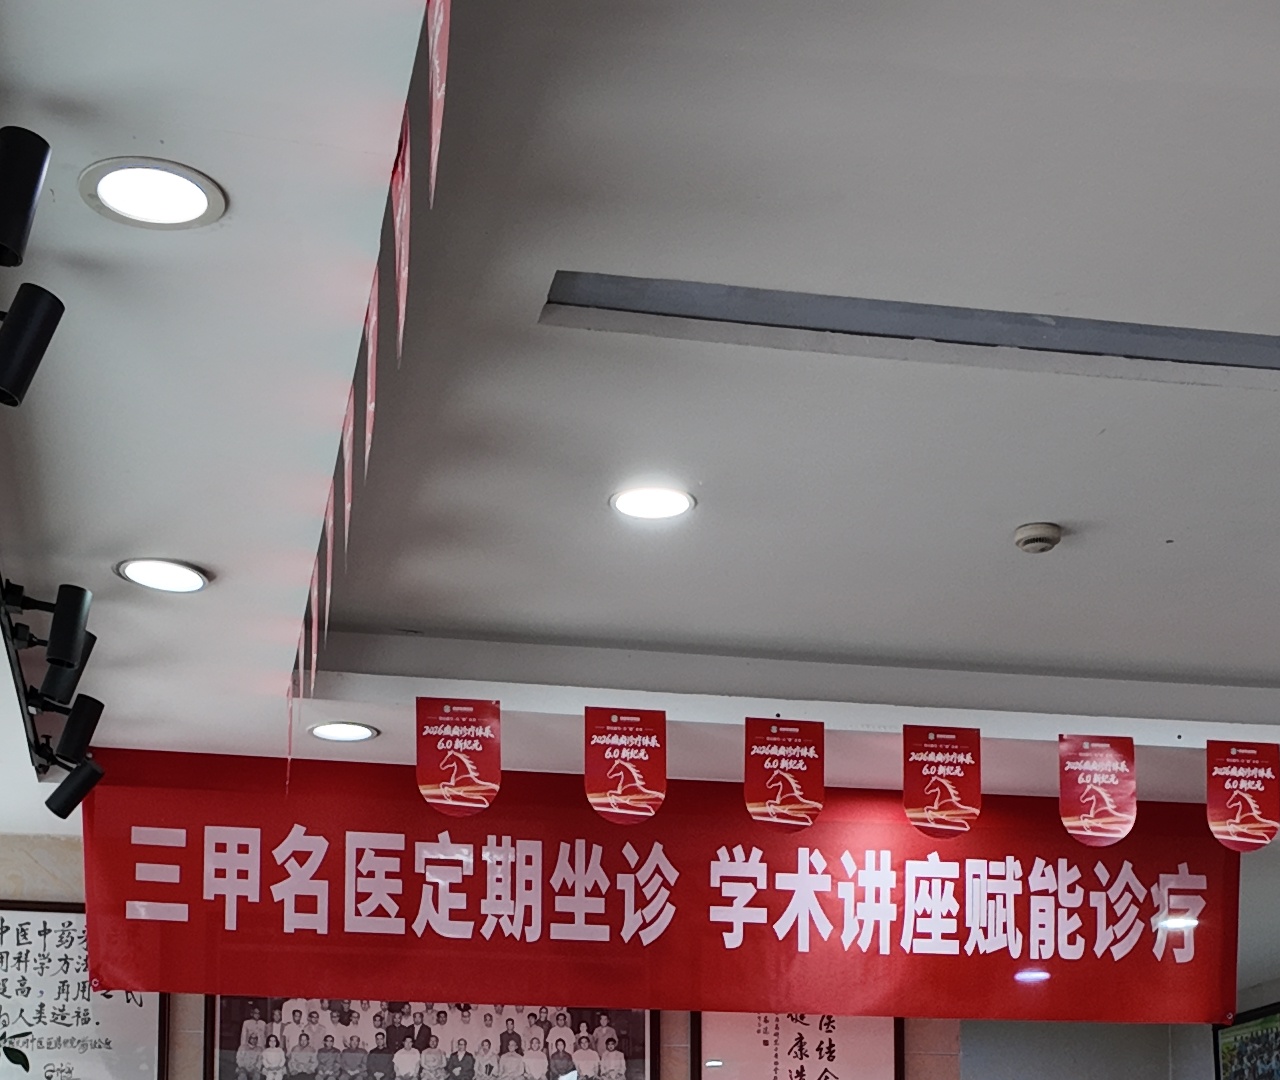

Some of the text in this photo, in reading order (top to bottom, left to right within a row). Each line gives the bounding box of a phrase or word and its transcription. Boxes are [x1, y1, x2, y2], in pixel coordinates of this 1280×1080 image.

[125, 823, 1208, 964] 三甲名医定期坐诊 学术讲座赋能诊疗
